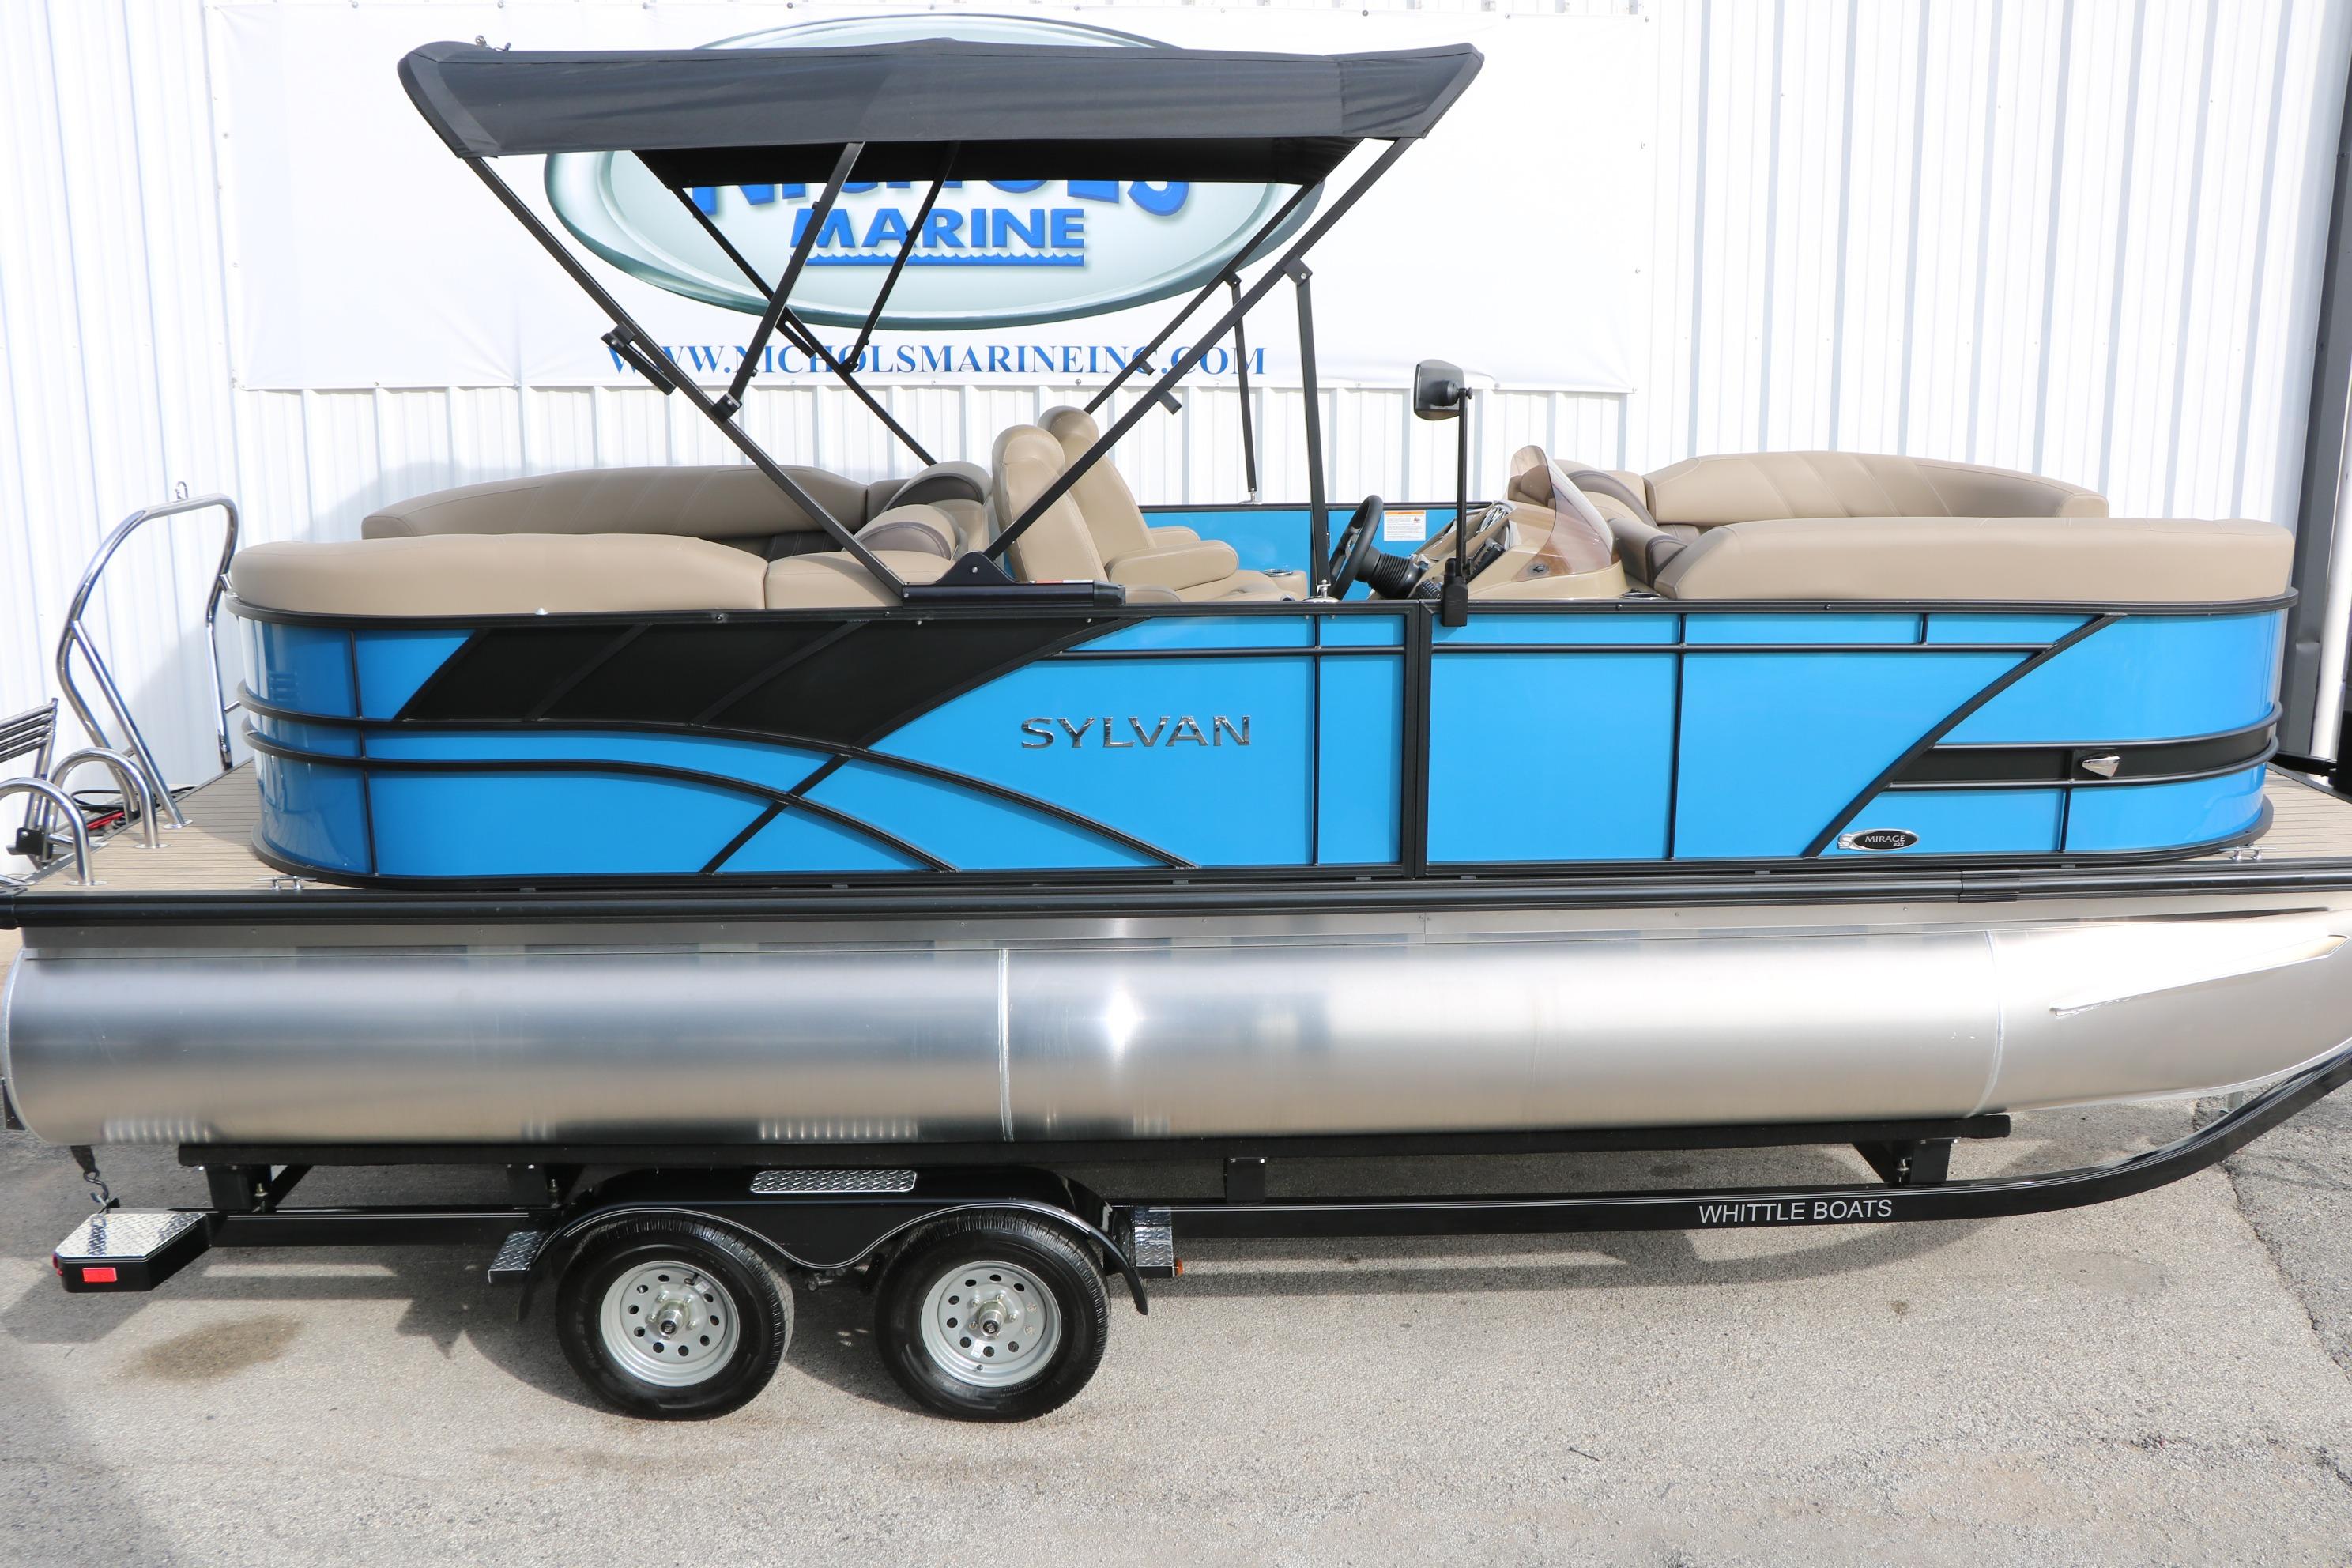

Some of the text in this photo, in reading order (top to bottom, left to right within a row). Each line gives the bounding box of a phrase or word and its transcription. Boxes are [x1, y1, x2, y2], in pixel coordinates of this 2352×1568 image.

[790, 209, 1085, 249] MARINE
[1020, 715, 1251, 749] SYLVAN
[1864, 835, 1905, 843] MIRAGE
[1699, 1199, 1893, 1223] WHITTLE BOATS
